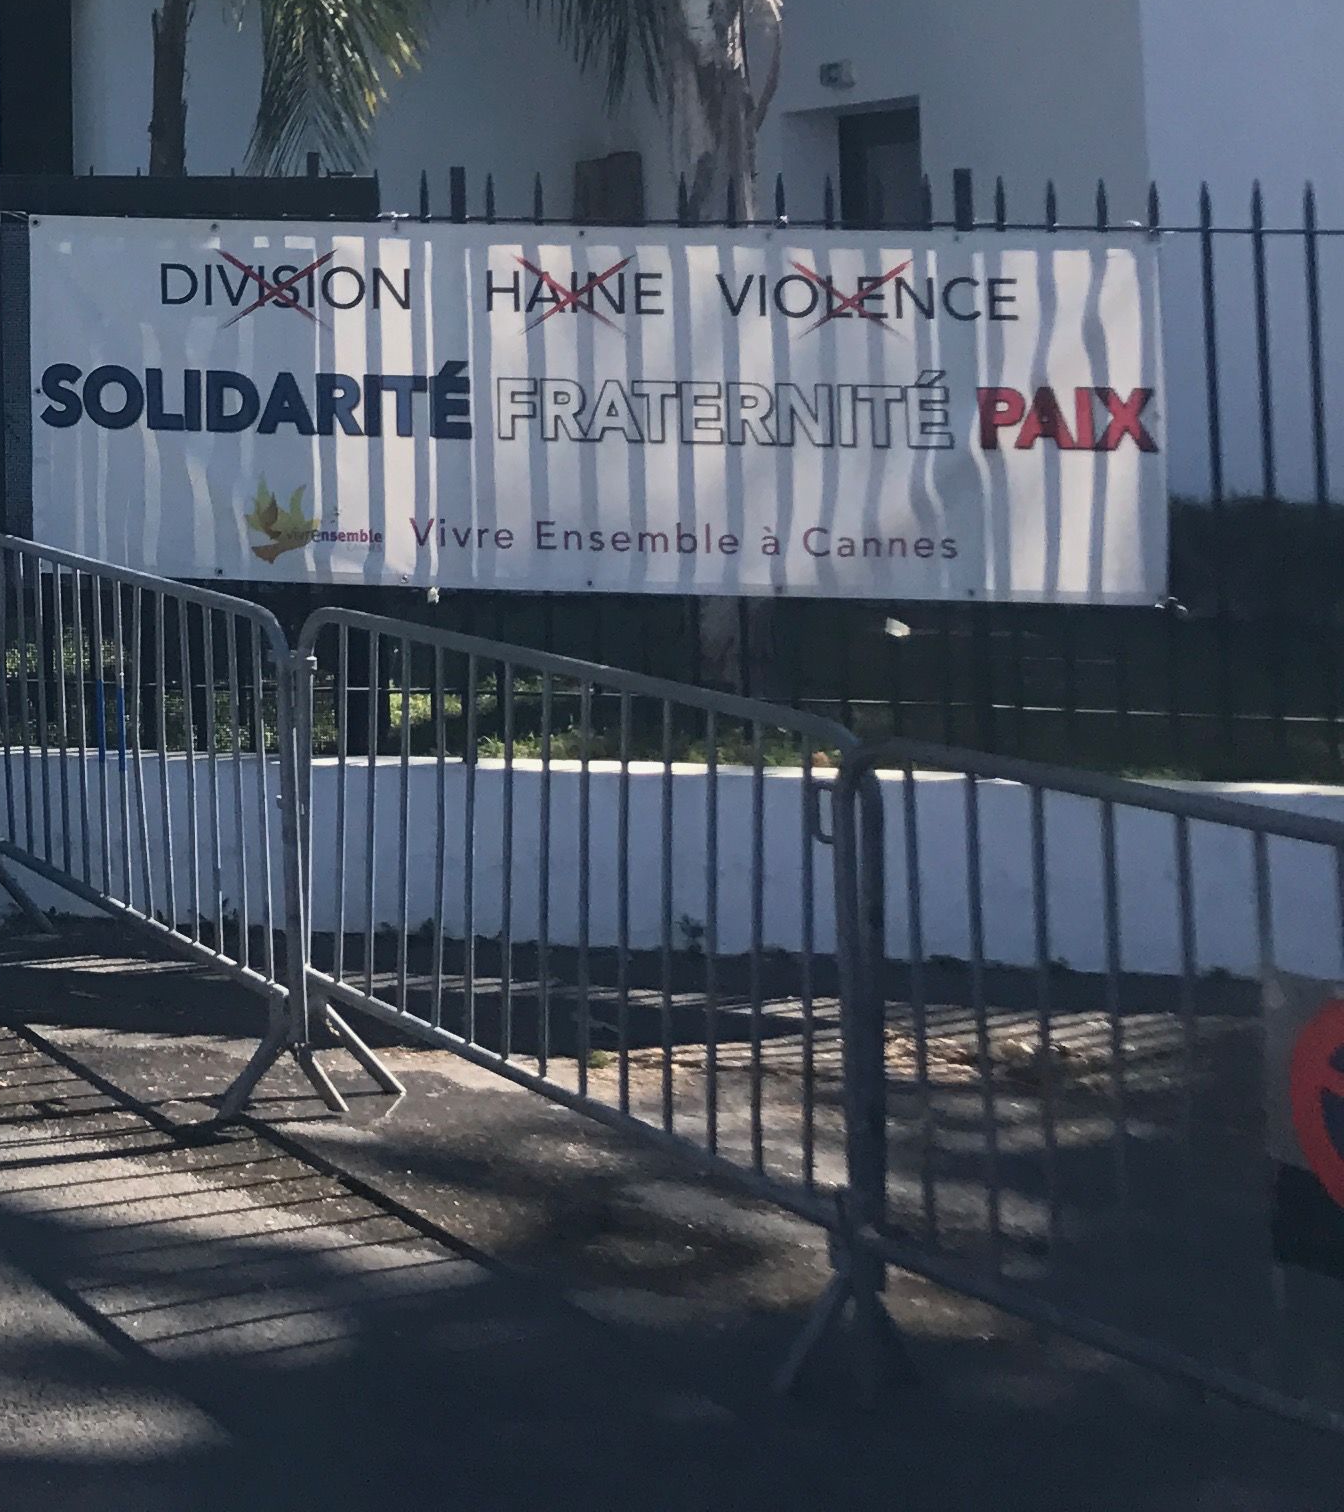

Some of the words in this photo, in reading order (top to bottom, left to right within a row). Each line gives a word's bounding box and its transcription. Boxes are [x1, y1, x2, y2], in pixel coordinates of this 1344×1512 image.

[160, 262, 411, 310] DIVISION
[485, 269, 665, 316] HAINE
[715, 272, 1020, 322] VIOLENCE
[40, 360, 473, 440] SOLIDARITÉ
[496, 370, 955, 450] FRATERNITÉ
[976, 386, 1159, 453] PAIX
[408, 517, 514, 550] Vivre
[535, 520, 740, 556] Ensemble
[761, 526, 782, 557] à
[802, 528, 959, 561] Cannes
